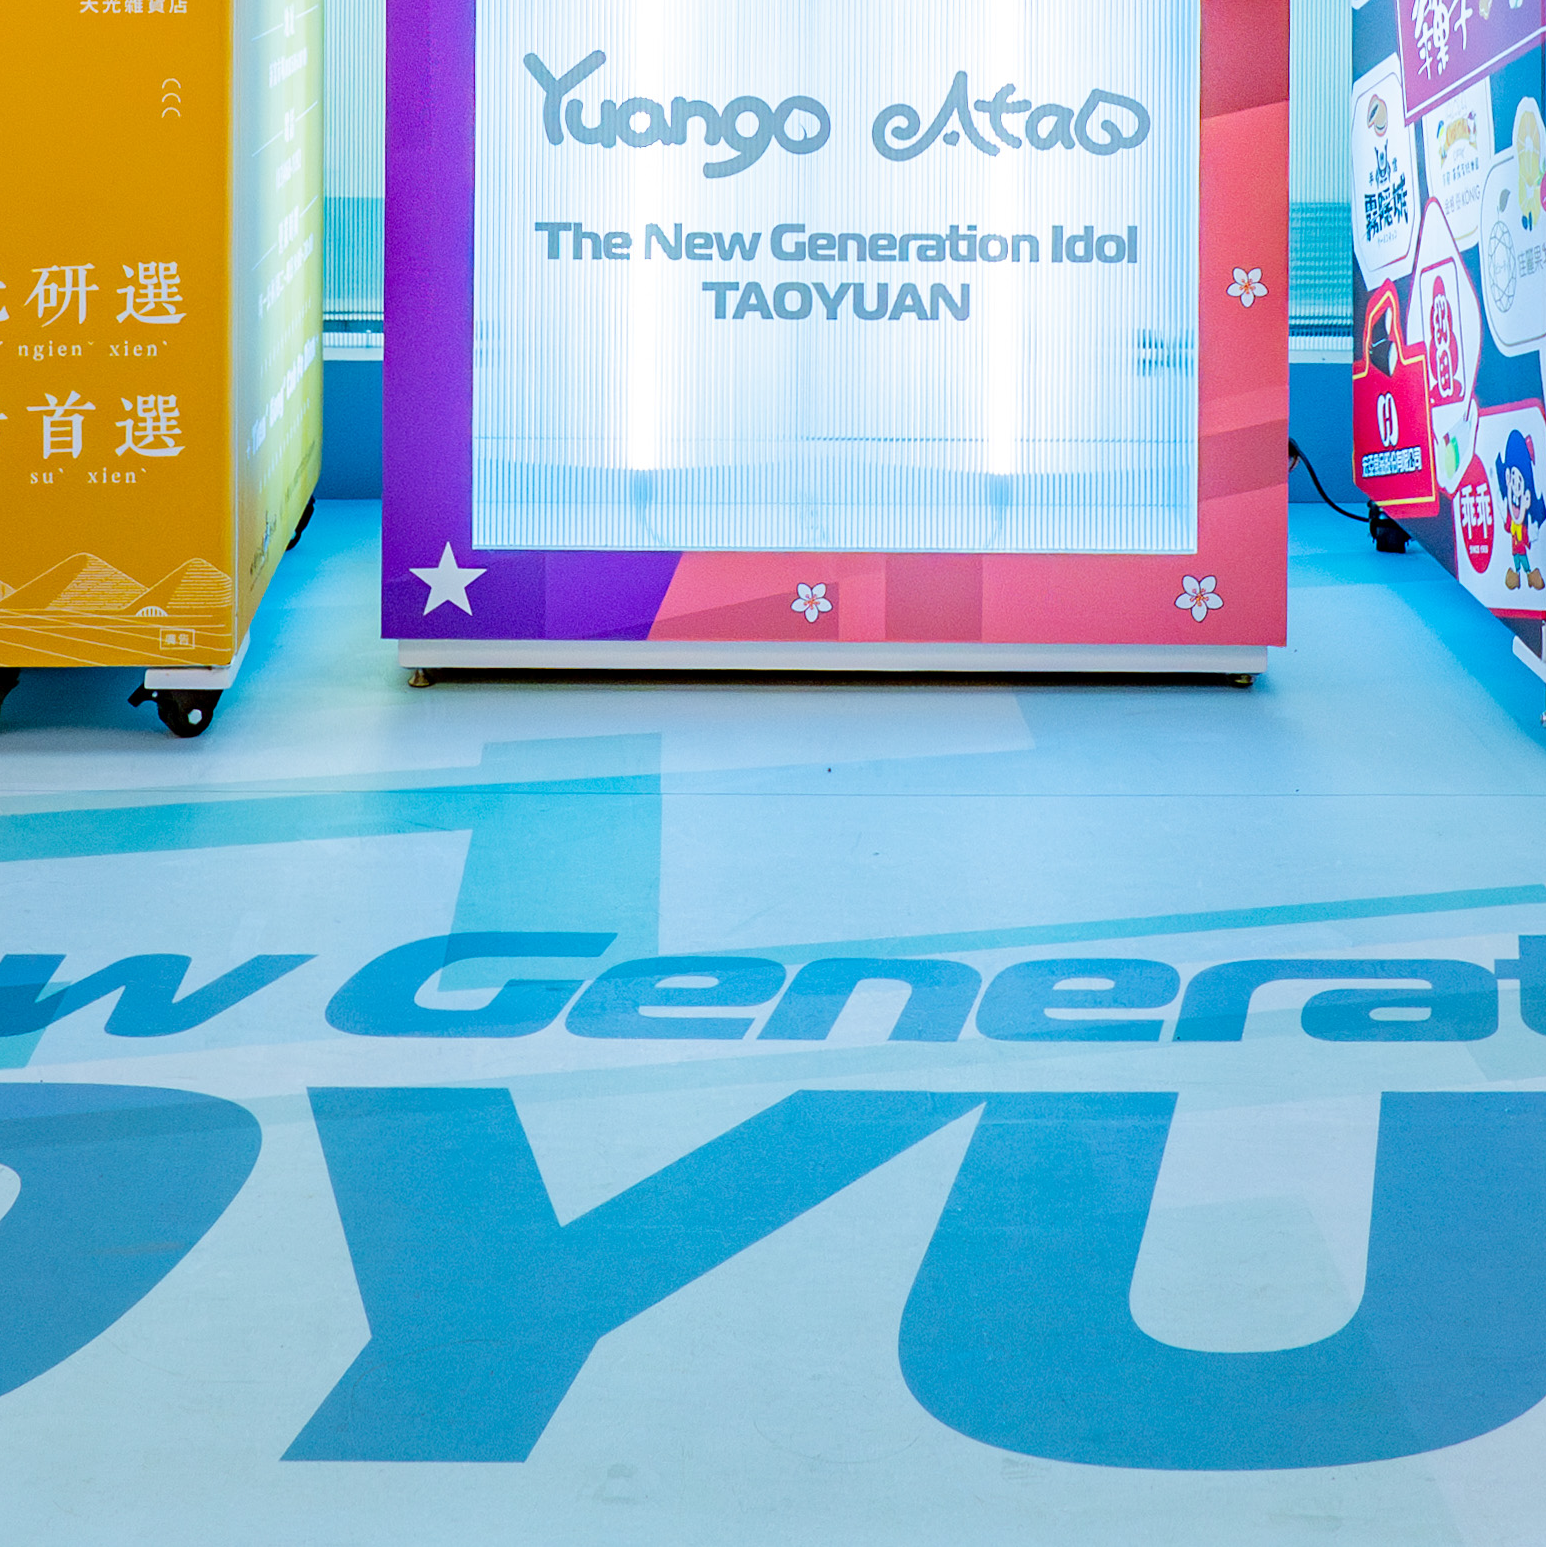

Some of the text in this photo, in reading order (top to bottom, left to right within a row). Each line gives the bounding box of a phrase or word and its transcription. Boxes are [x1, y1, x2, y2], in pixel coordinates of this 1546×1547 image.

[523, 50, 831, 179] Yuango
[535, 222, 1138, 264] The New Generation Idol
[702, 281, 971, 322] TAOYUAN
[1461, 482, 1493, 541] 乖乖
